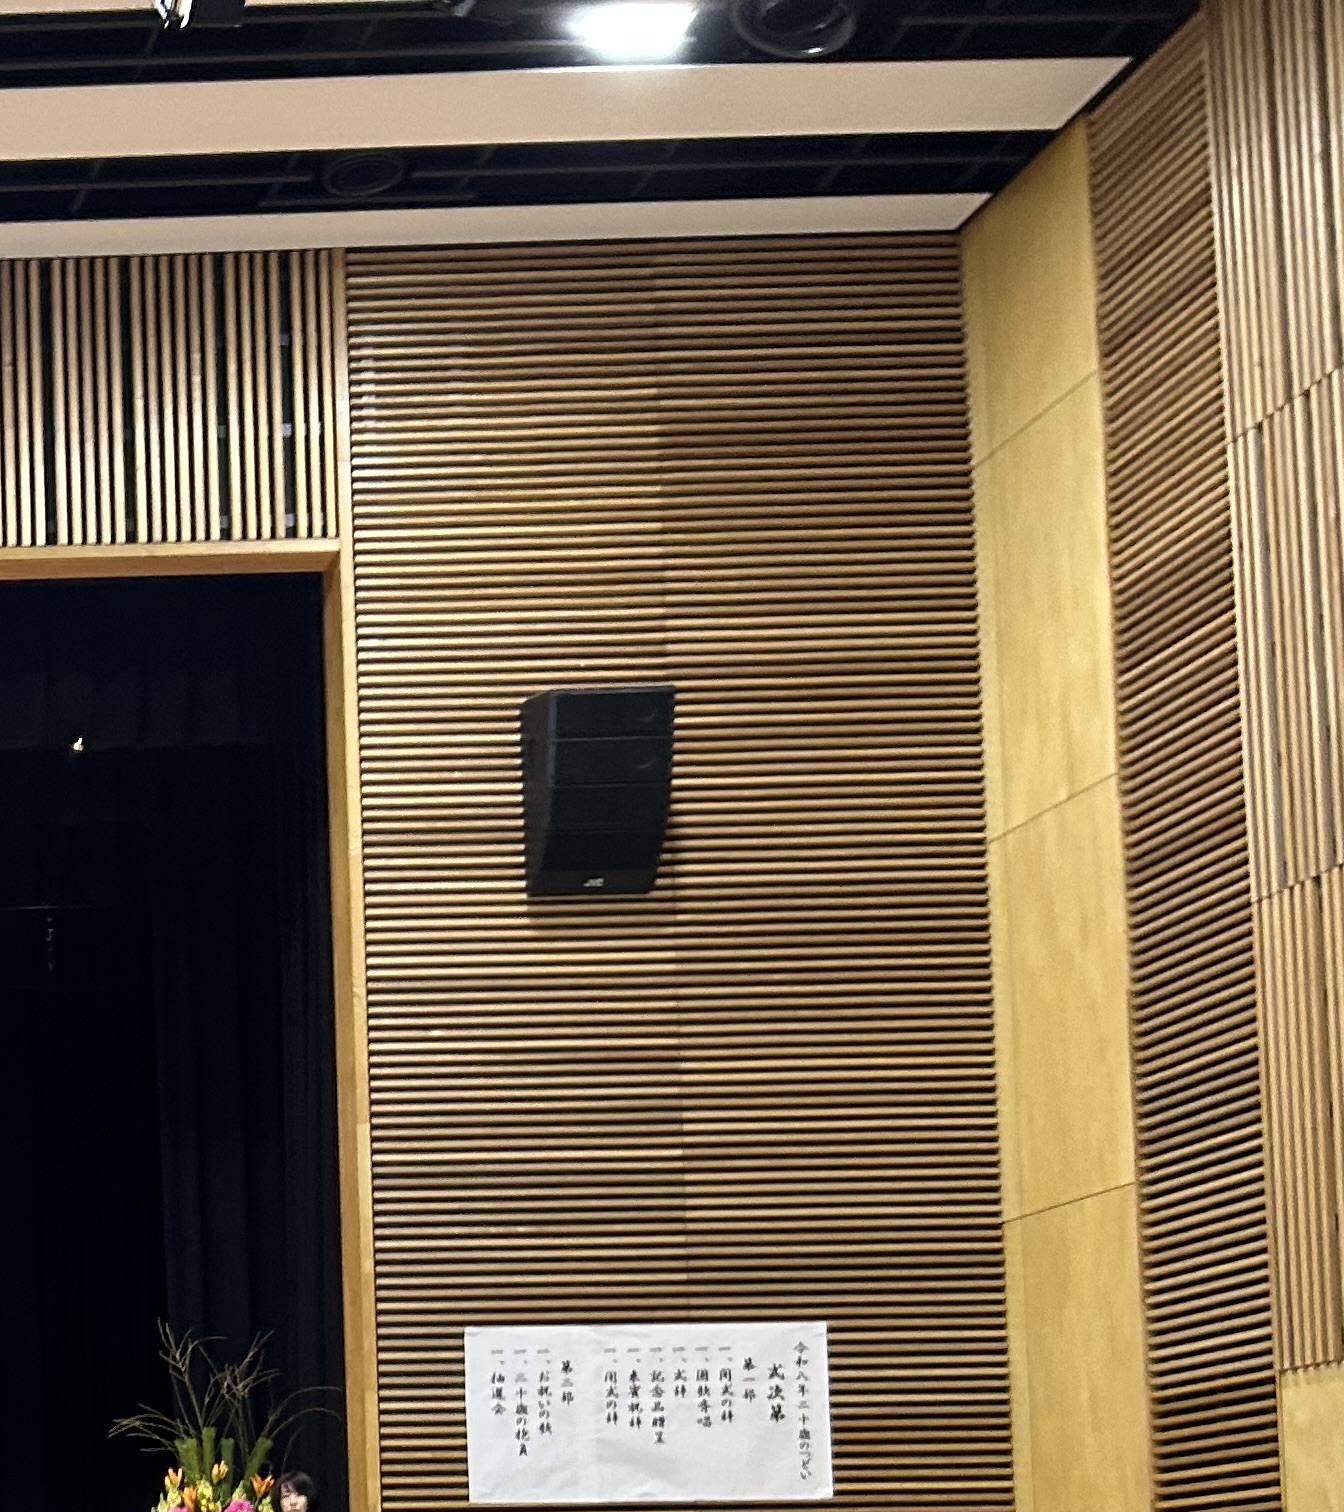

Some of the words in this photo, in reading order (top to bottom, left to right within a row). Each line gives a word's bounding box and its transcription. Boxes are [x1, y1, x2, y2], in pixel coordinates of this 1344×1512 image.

[560, 1360, 574, 1405] 第二部
[743, 1357, 756, 1403] 第一部
[767, 1363, 786, 1423] 式次第
